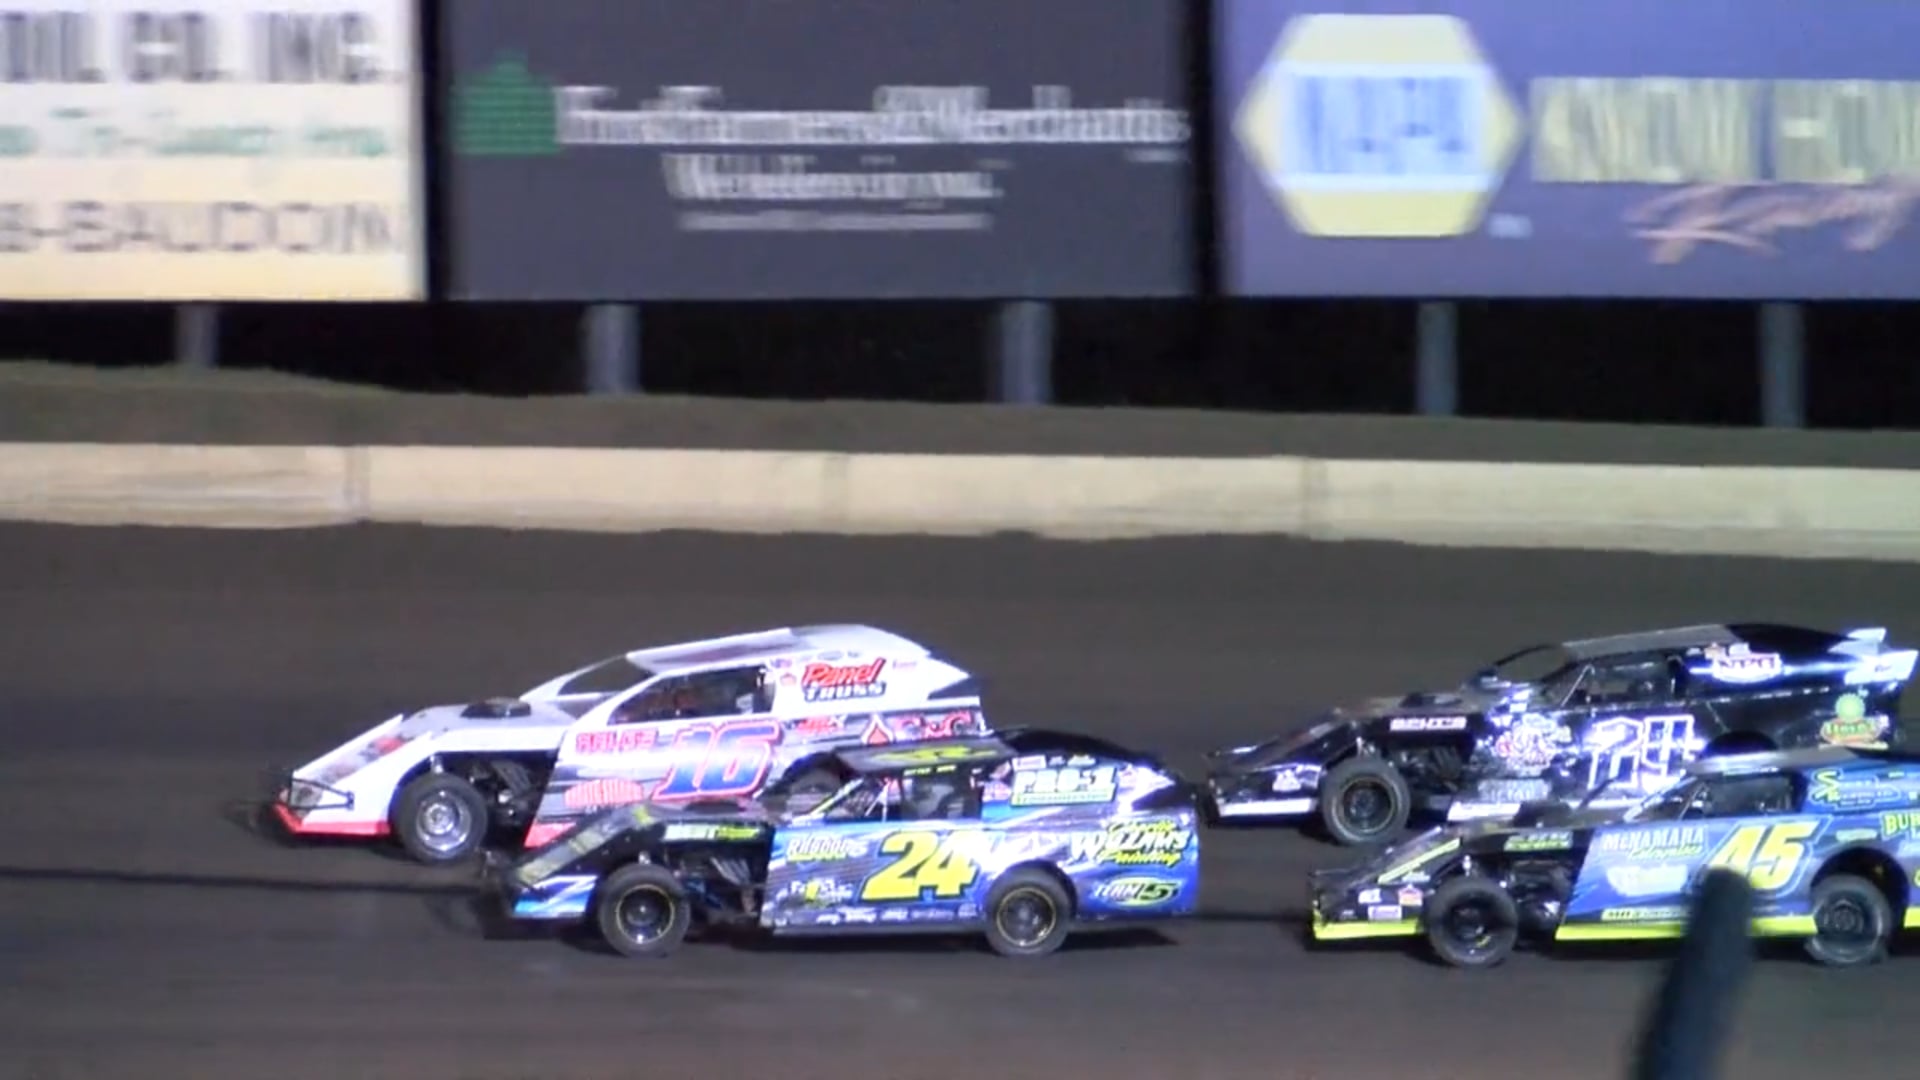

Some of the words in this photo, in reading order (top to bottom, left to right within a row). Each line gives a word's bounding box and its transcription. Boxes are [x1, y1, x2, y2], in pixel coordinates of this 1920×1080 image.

[802, 657, 886, 688] Panel
[652, 718, 784, 802] 16
[859, 829, 982, 902] 24
[1706, 820, 1821, 891] 45
